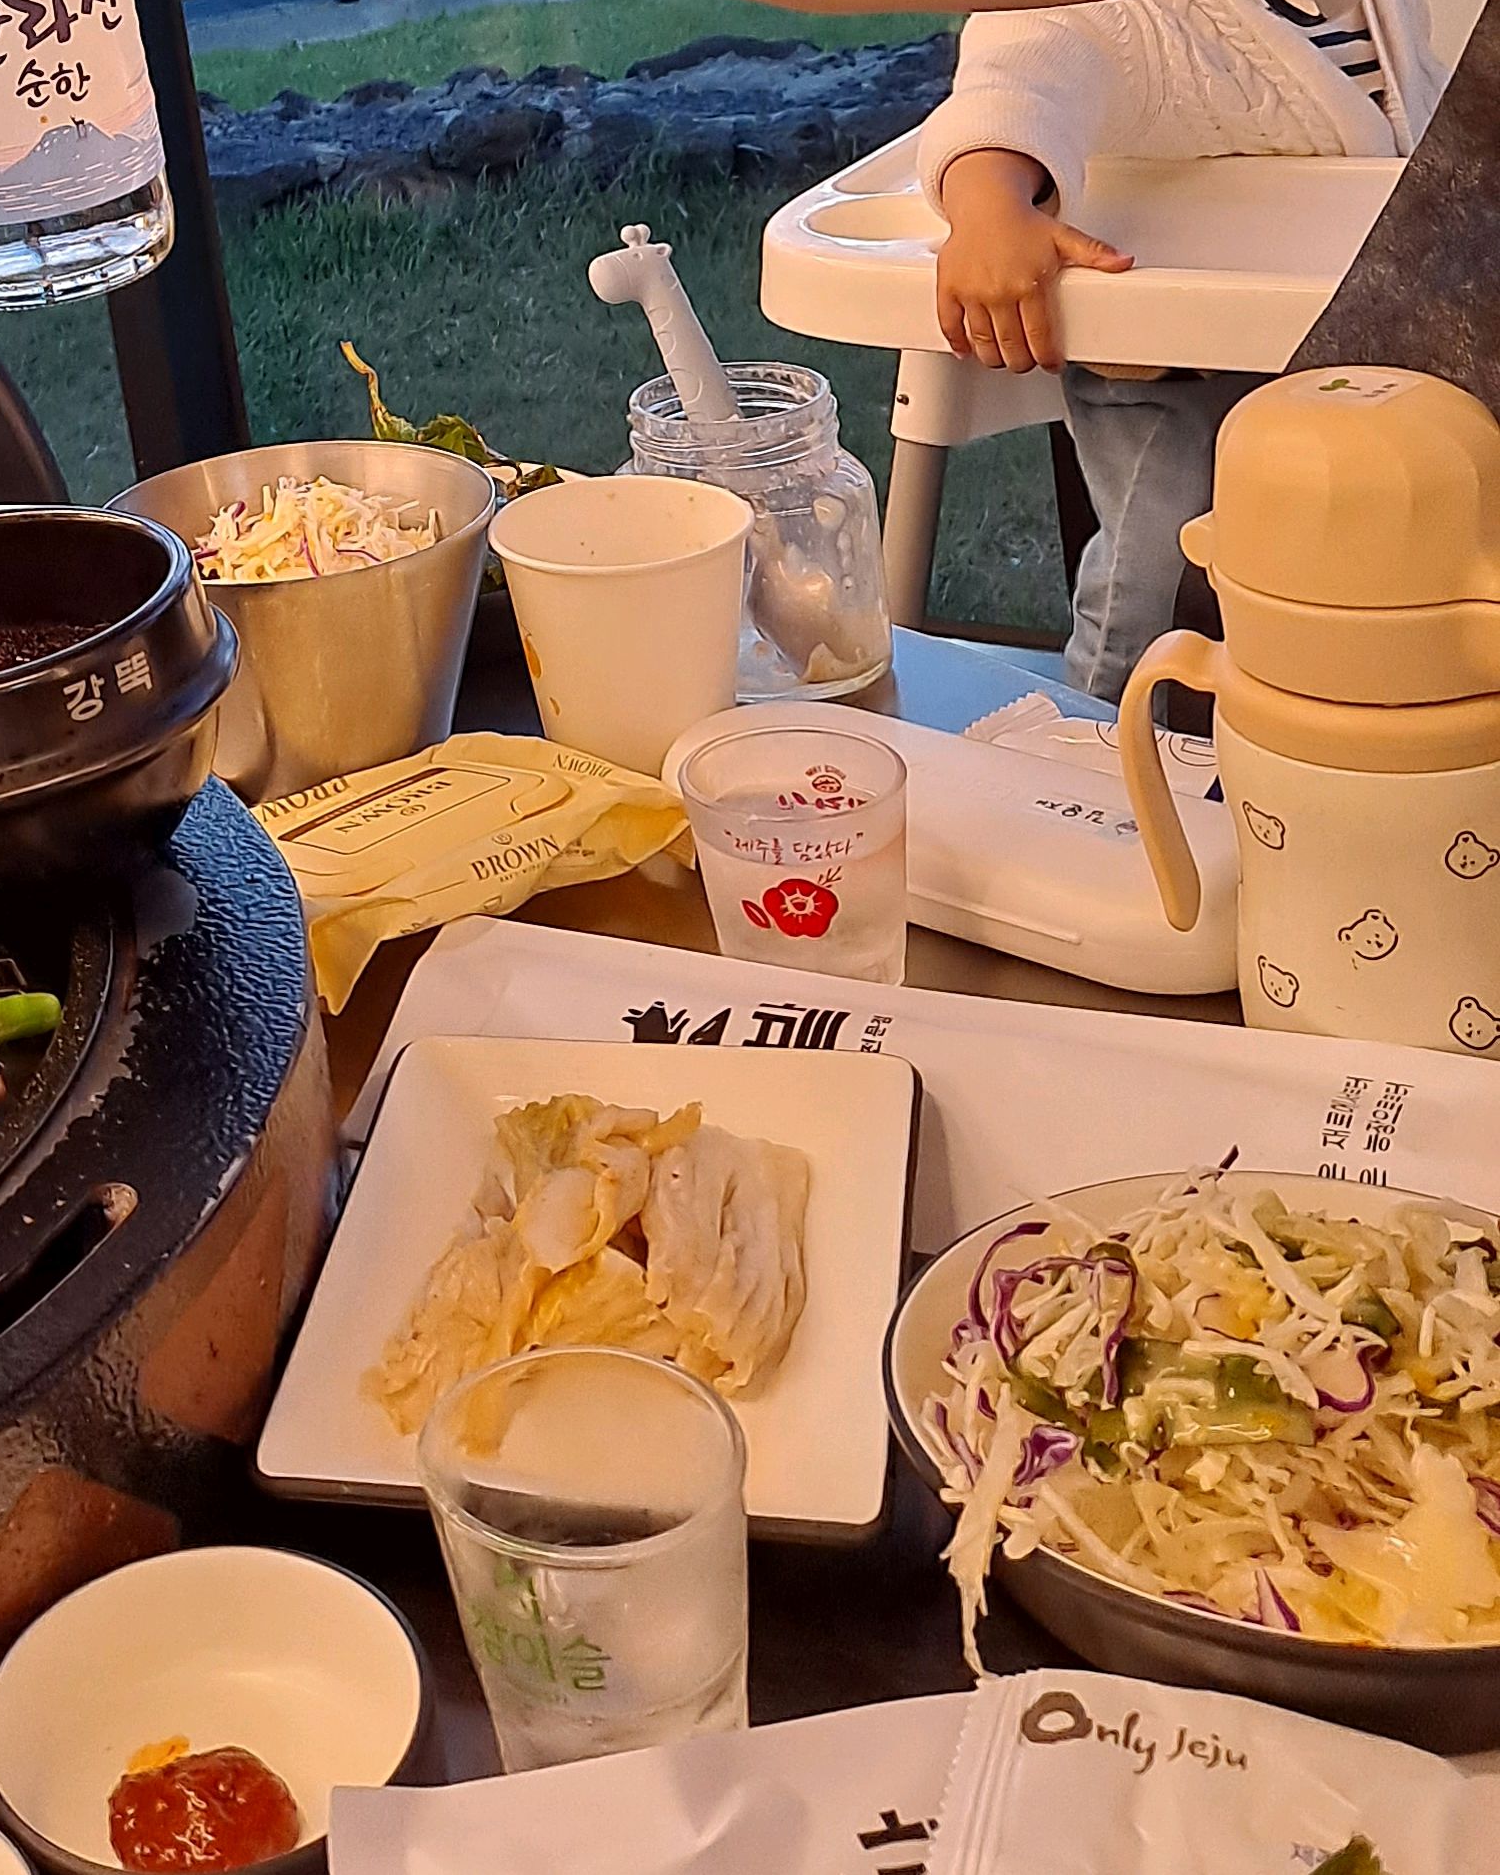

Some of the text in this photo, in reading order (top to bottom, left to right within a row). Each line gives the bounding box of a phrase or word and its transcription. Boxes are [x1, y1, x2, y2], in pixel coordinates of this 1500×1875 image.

[15, 58, 91, 108] 순한
[333, 780, 453, 835] BROWN
[471, 834, 561, 881] BROWN
[1020, 1691, 1249, 1775] Only Jeju
